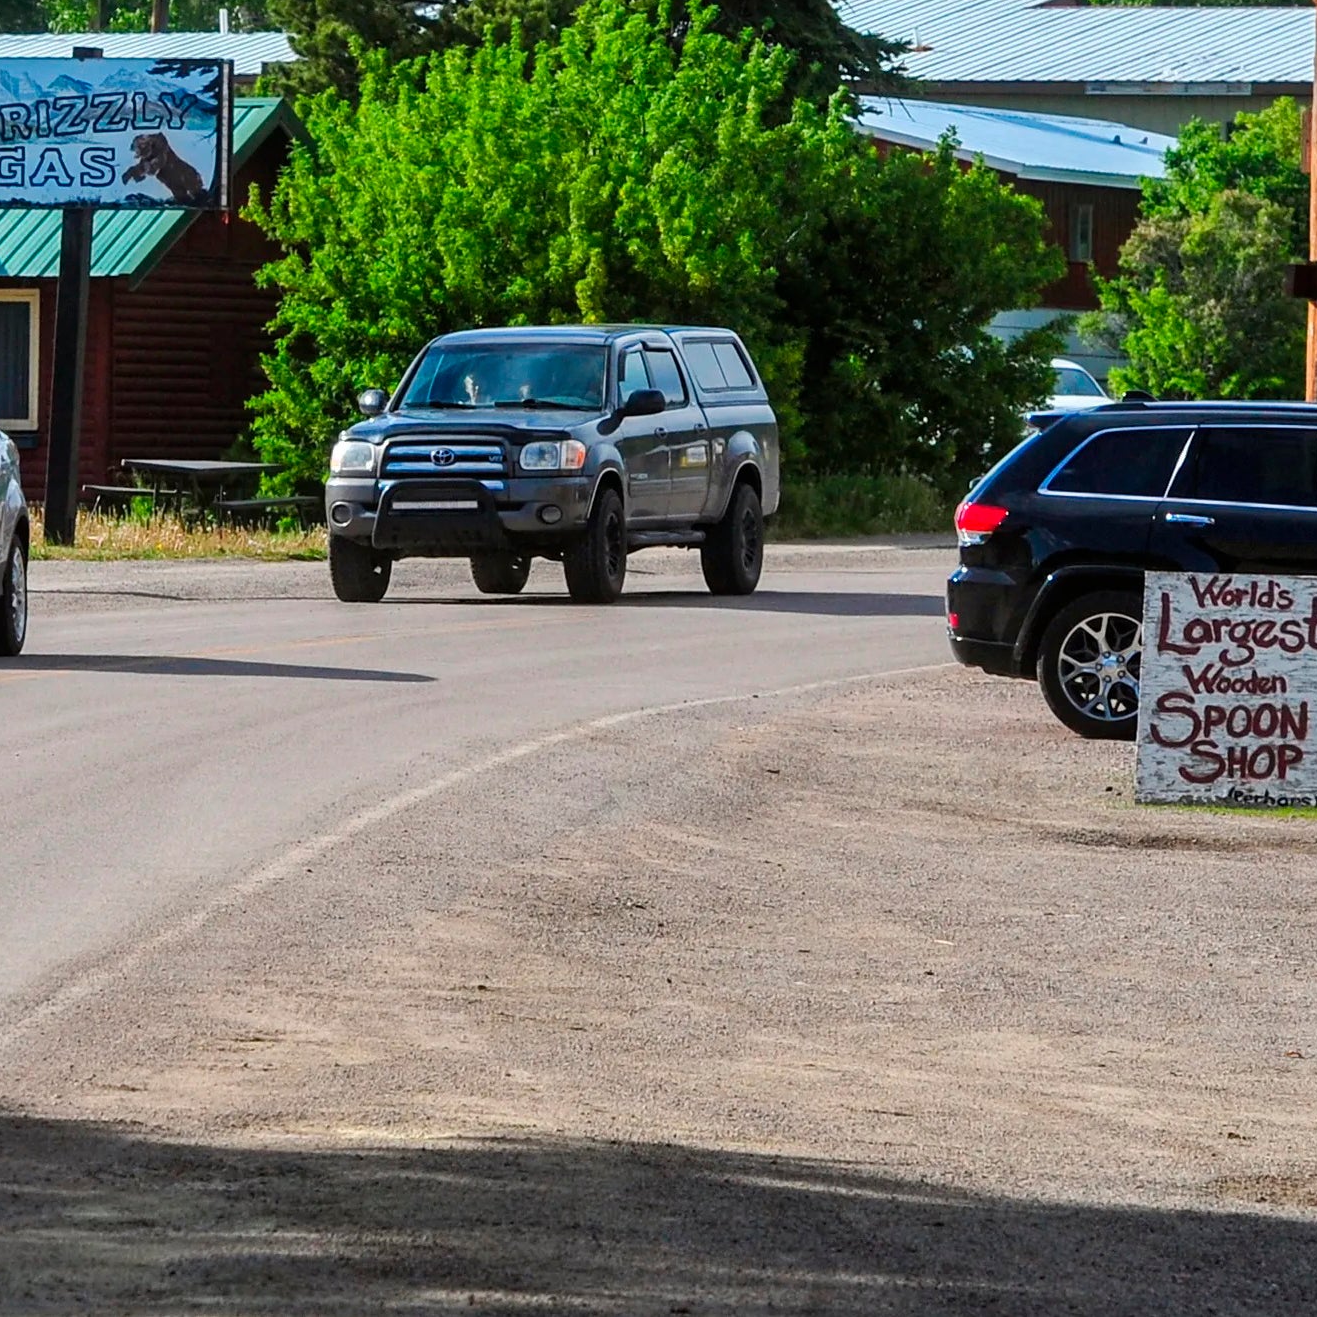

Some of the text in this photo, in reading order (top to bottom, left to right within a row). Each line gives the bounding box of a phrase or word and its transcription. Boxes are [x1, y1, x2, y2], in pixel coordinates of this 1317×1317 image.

[1189, 574, 1295, 610] World's
[1183, 663, 1287, 695] Wooden
[1149, 692, 1309, 748] SPOON
[1178, 739, 1304, 783] SHOP
